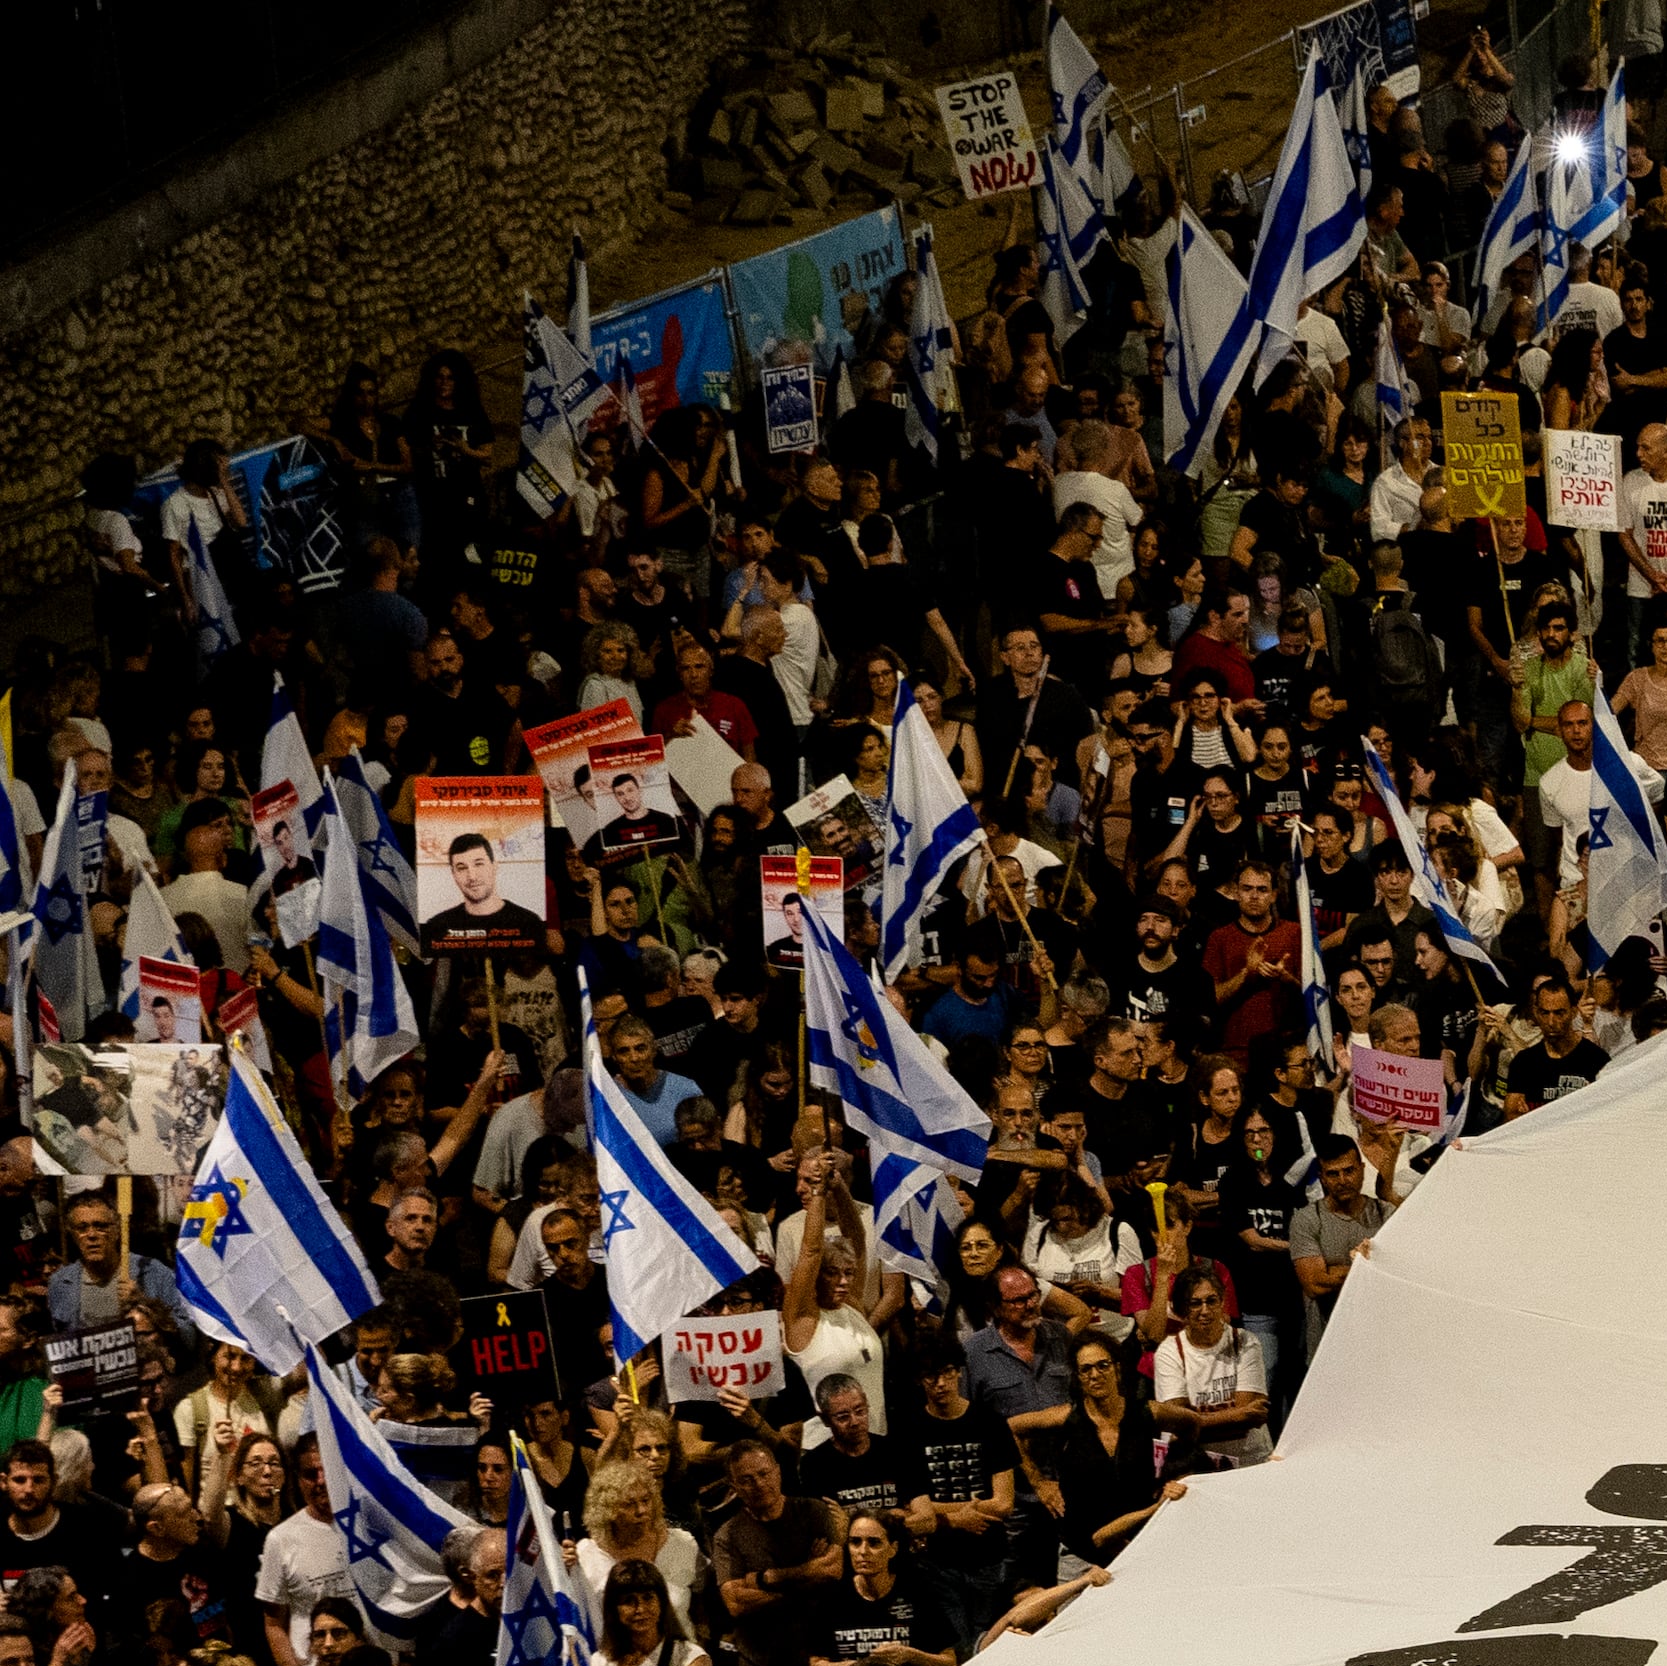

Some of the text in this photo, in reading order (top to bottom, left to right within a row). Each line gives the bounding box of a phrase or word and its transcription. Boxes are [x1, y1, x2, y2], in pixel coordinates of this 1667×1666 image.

[949, 80, 1012, 112] STOP
[961, 106, 1009, 133] THE
[971, 132, 1021, 161] WAR
[969, 152, 1041, 195] NOW
[1455, 399, 1501, 421] קודם
[1475, 418, 1504, 437] כל
[1354, 1072, 1440, 1105] נשים דורשות
[1396, 1103, 1438, 1122] עסקה
[470, 1331, 549, 1377] HELP
[675, 1328, 765, 1365] עסקה
[690, 1361, 773, 1389] עכשיו
